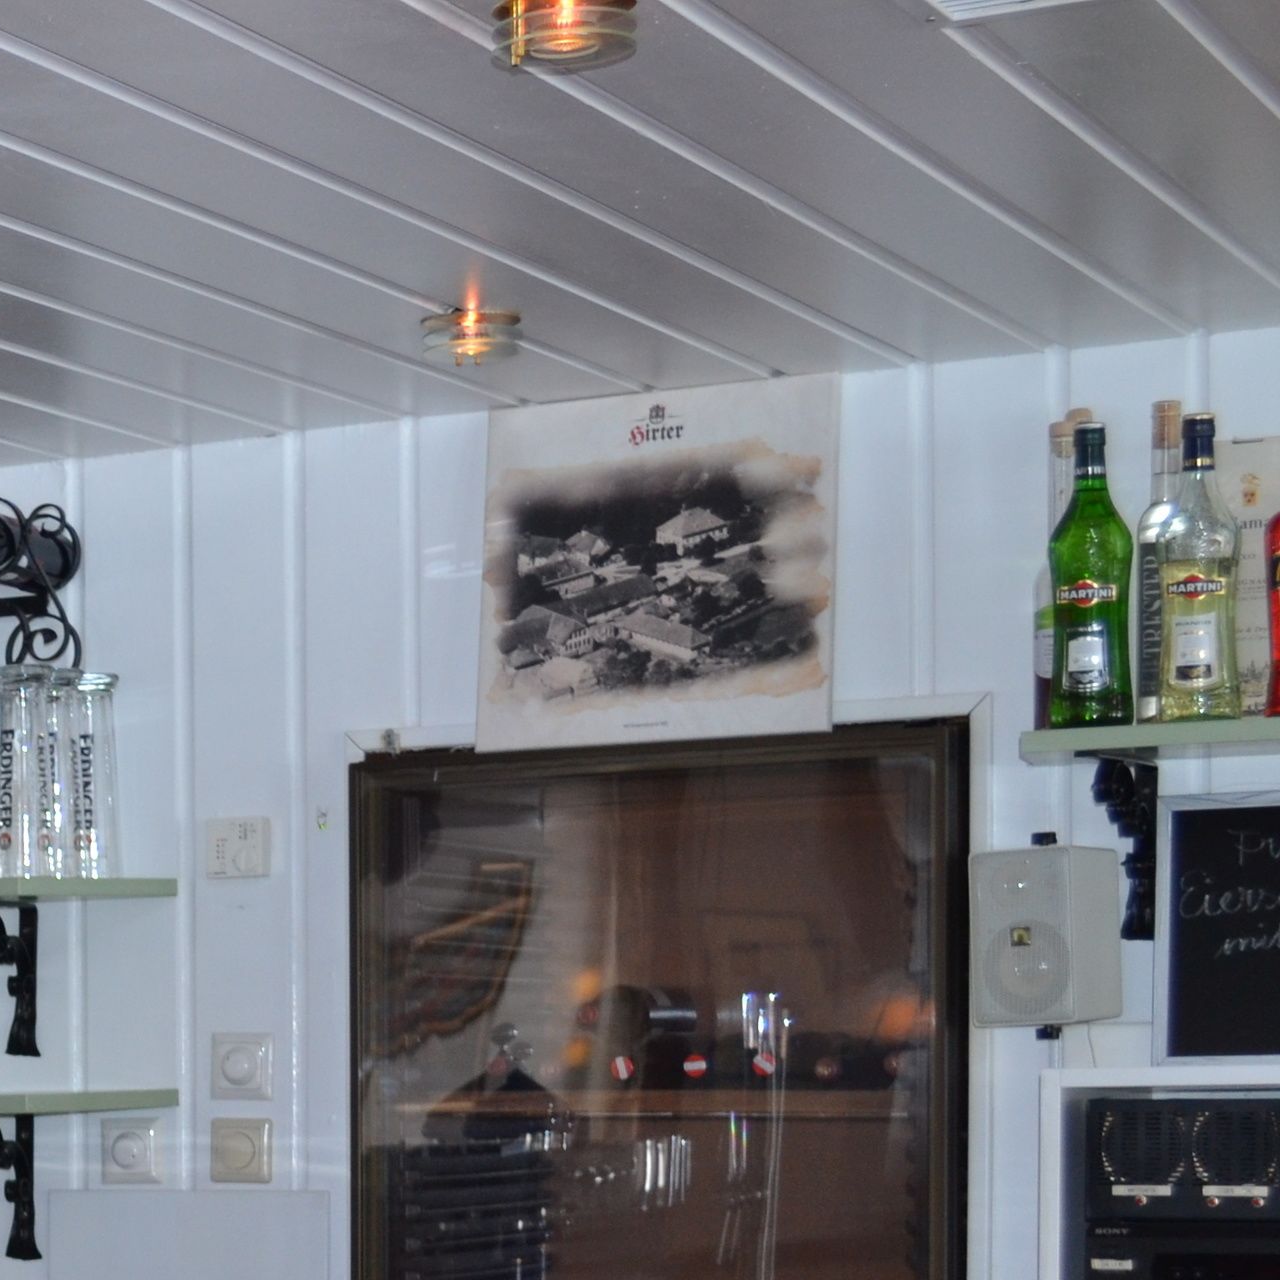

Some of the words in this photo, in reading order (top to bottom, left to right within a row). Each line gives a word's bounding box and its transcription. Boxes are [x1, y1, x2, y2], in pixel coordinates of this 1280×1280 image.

[628, 423, 684, 447] Hirter
[1060, 587, 1112, 601] MARTINI
[1168, 582, 1221, 595] MARTINI
[1094, 1227, 1130, 1235] SONY
